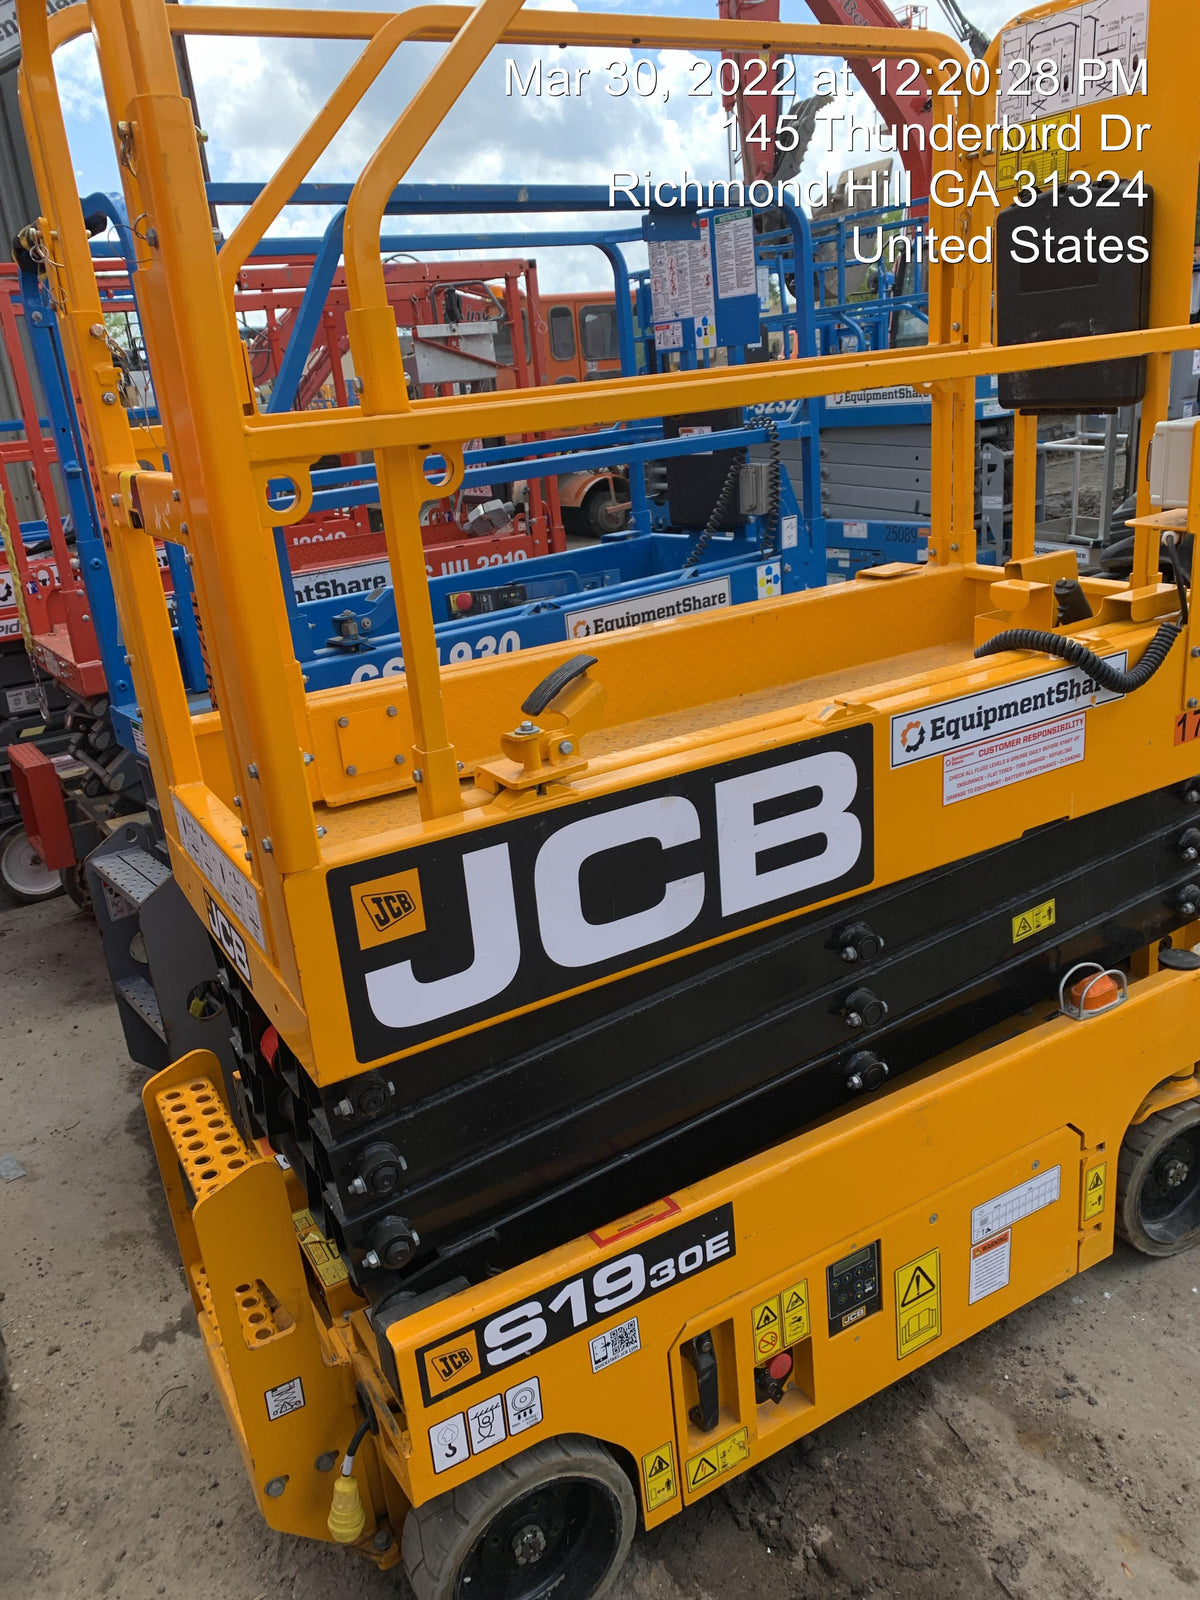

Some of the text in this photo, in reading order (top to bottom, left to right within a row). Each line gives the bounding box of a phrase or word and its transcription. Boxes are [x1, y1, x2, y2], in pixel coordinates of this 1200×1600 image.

[885, 525, 918, 544] 25089
[593, 592, 727, 635] EquipmentShare
[978, 717, 1085, 757] CUSTOMER RESPONSIBILITY
[949, 771, 965, 781] CHECK
[965, 768, 974, 777] ALL
[989, 760, 1006, 772] LEVELS
[1011, 753, 1028, 765] GREASE
[1028, 748, 1042, 759] DAILY
[1042, 743, 1059, 755] BEFORE
[1059, 738, 1073, 749] START
[946, 789, 966, 801] DAMAGE
[967, 787, 974, 795] TO
[974, 778, 1002, 793] EQUIPMENT
[1004, 771, 1025, 783] BATTERY
[1025, 761, 1057, 776] MAINTENANCE
[956, 775, 984, 789] INSURANCE
[987, 769, 998, 779] FLAT
[365, 751, 863, 1029] JCB
[371, 890, 414, 926] JCB
[208, 900, 250, 982] JCB
[982, 1233, 1008, 1252] WARNING
[843, 1308, 865, 1325] JCB
[438, 1349, 471, 1378] JCB
